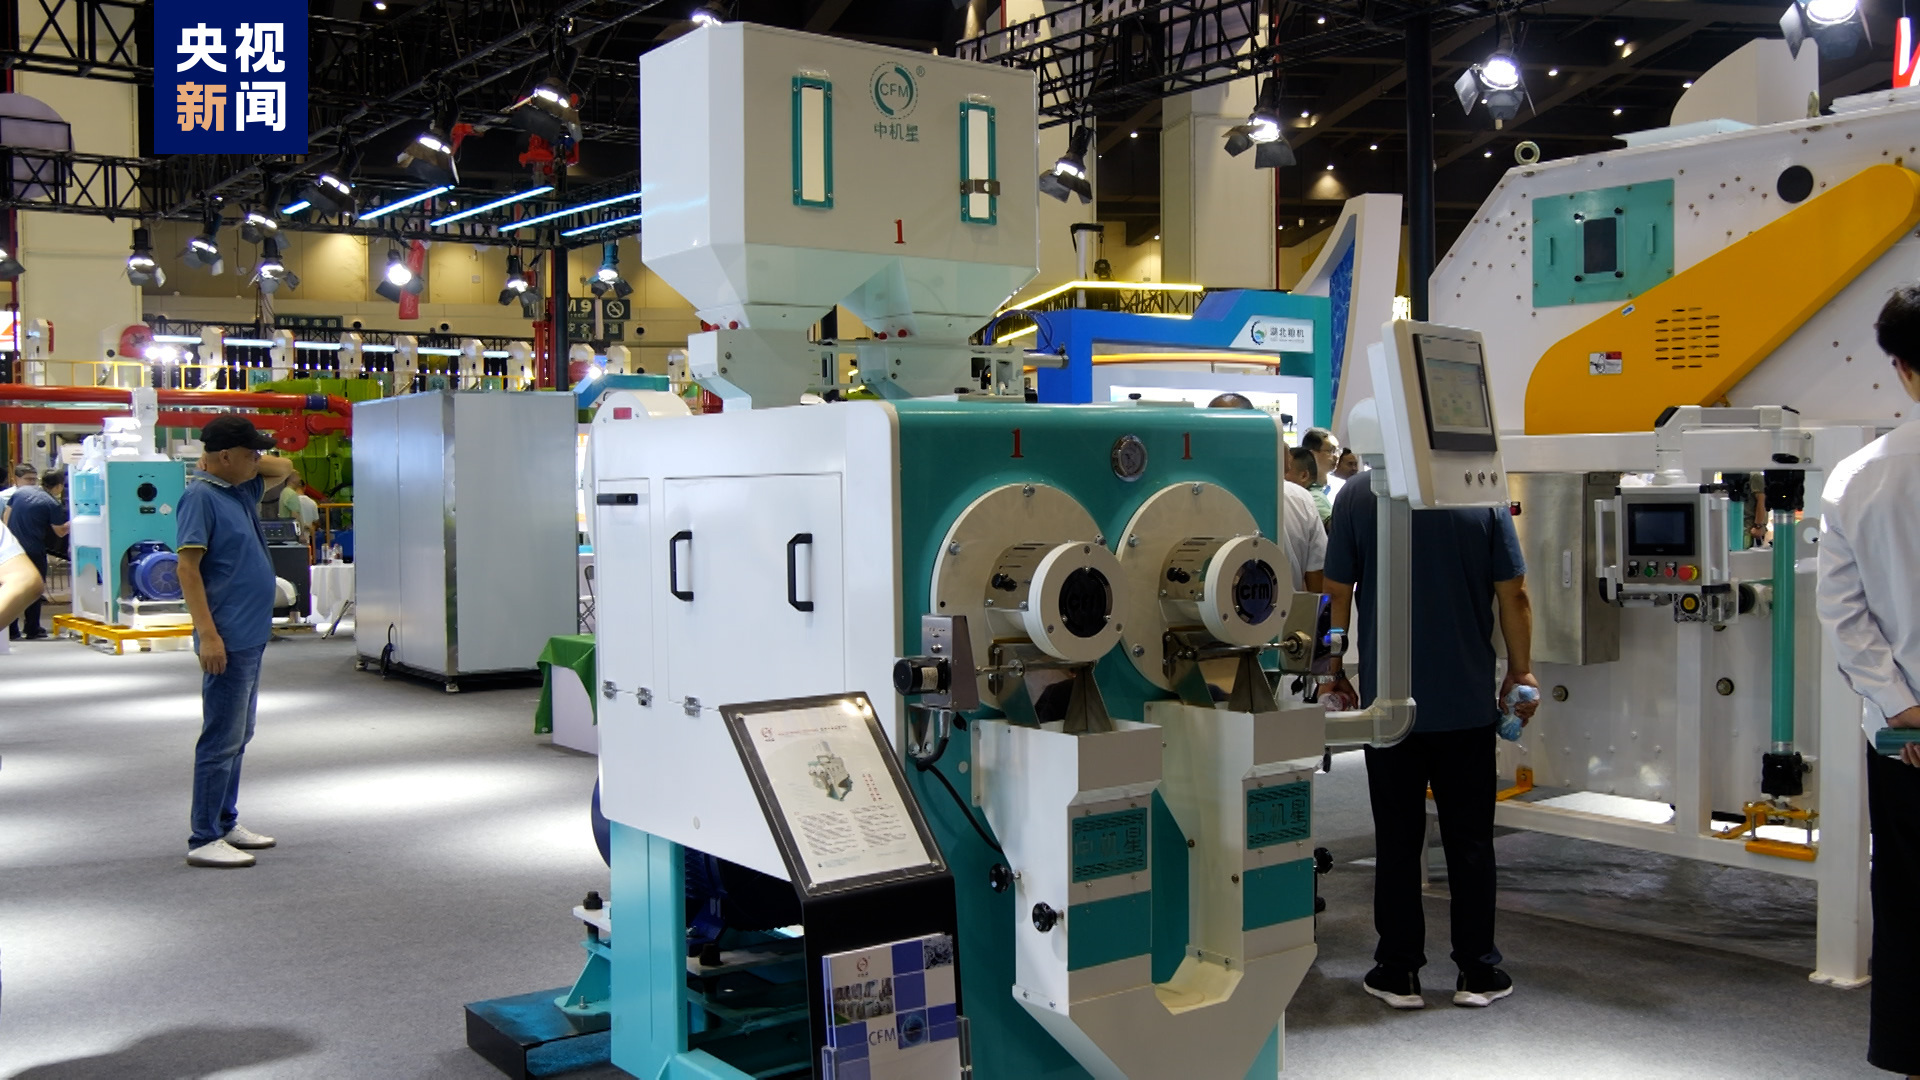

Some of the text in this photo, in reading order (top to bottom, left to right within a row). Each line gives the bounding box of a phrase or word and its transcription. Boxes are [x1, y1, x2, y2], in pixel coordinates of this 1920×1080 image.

[880, 83, 909, 98] CFM
[874, 121, 919, 142] 中机星
[894, 219, 906, 244] 1
[1010, 428, 1024, 458] 1
[1181, 432, 1193, 460] 1
[868, 1027, 897, 1046] CFM
